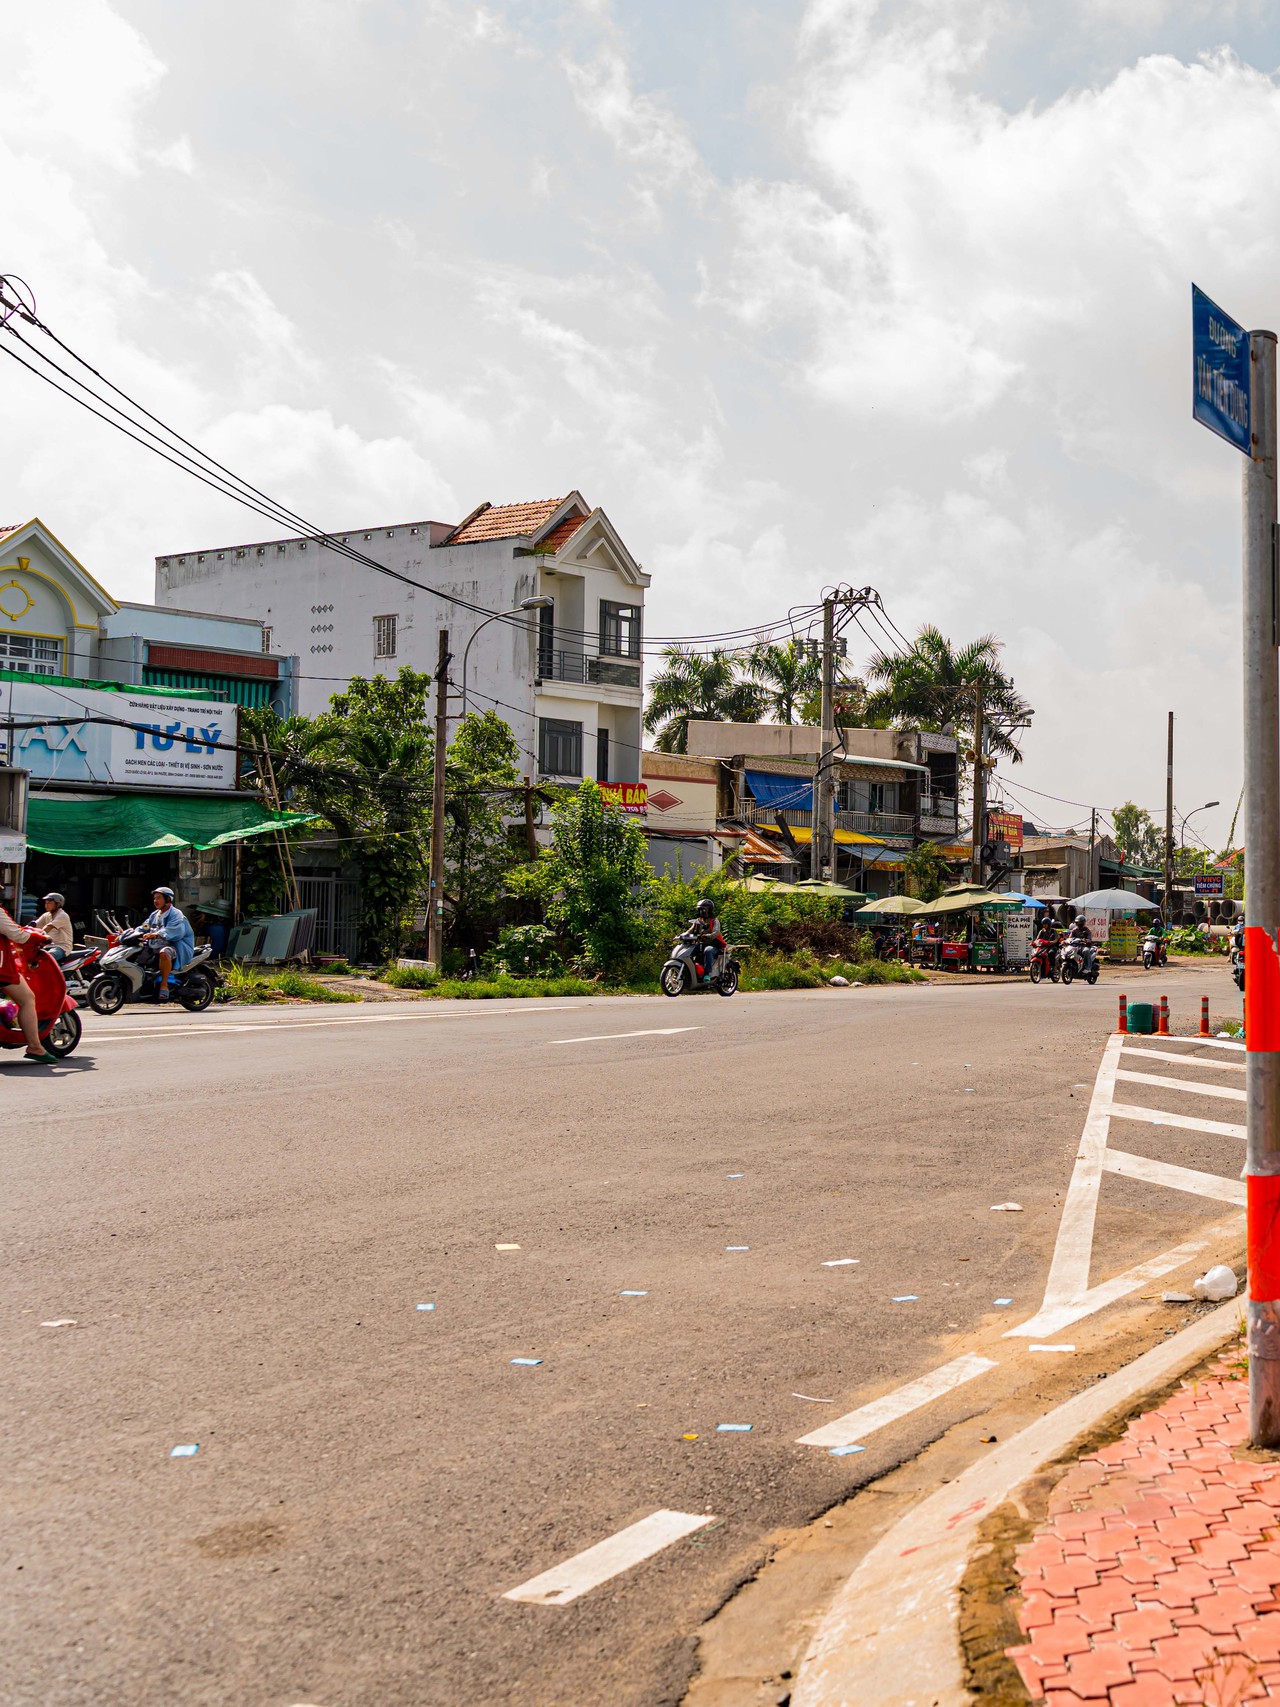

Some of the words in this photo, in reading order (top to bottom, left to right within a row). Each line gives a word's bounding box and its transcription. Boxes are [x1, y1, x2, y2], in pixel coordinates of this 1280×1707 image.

[132, 722, 180, 751] TƯ
[186, 723, 222, 754] LÝ
[626, 784, 647, 804] BÁN
